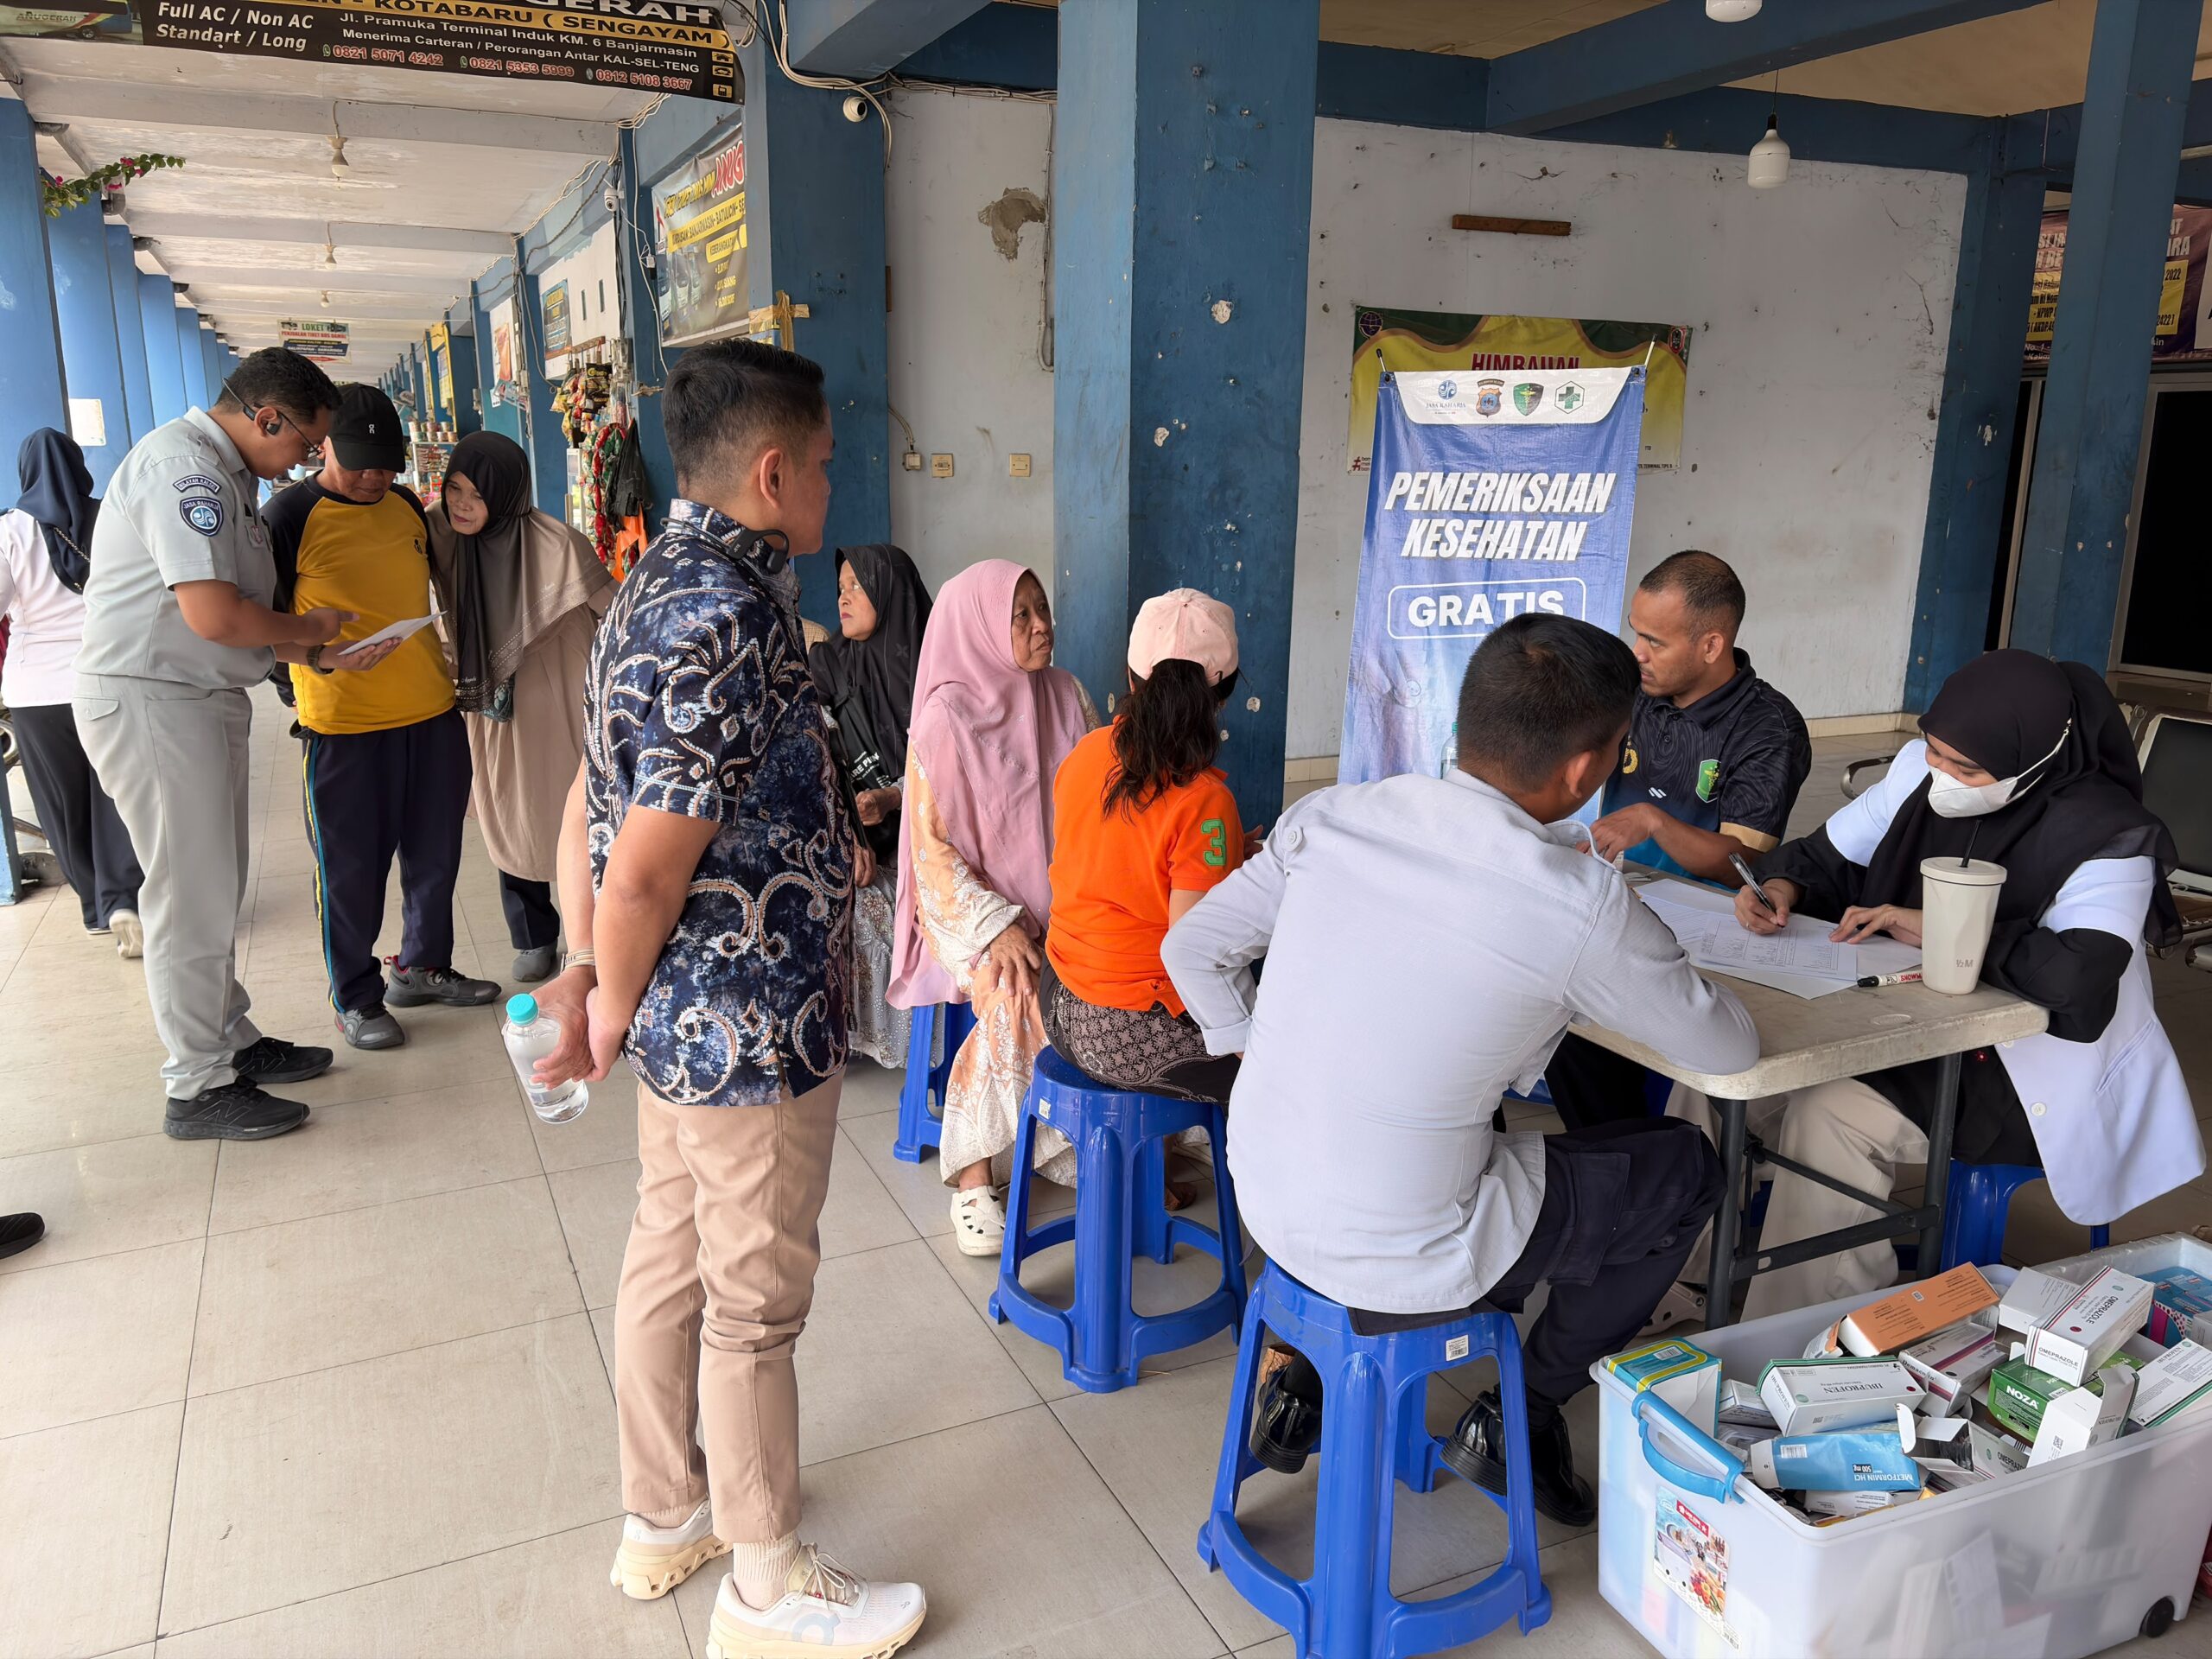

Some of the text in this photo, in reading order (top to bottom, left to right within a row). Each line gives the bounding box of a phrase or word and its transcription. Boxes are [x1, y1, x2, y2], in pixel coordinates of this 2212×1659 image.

[158, 3, 314, 29] Full AC / Non AC
[375, 0, 531, 22] KOTABARU
[563, 16, 712, 43] SENGAYAM
[156, 24, 307, 52] Standart / Long
[364, 15, 435, 30] Pramuka
[440, 22, 507, 37] Terminal
[512, 29, 555, 42] Induk
[560, 35, 588, 46] KM.
[593, 36, 601, 47] 6
[606, 39, 697, 59] Banjarmasin
[333, 44, 443, 66] 0821 5071 4242
[342, 29, 411, 43] Menerima
[415, 35, 474, 49] Carteran
[485, 41, 561, 58] Perorangan
[564, 50, 599, 62] Antar
[603, 54, 700, 73] KAL-SEL-TENG
[469, 57, 575, 77] 0821 5353 5999
[595, 69, 692, 90] 0812 5108 3667
[2164, 269, 2182, 280] 2022
[1384, 472, 1617, 513] PEMERIKSAAN
[1401, 518, 1587, 561] KESEHATAN
[1408, 590, 1564, 627] GRATIS
[1201, 819, 1226, 866] 3
[2086, 1295, 2119, 1325] OMEPRAZOLE
[1902, 1359, 1936, 1381] Demacoin
[2038, 1347, 2079, 1367] OMEPRAZOLE
[1824, 1382, 1885, 1394] IBUPROFEN
[2006, 1385, 2038, 1410] NOZA
